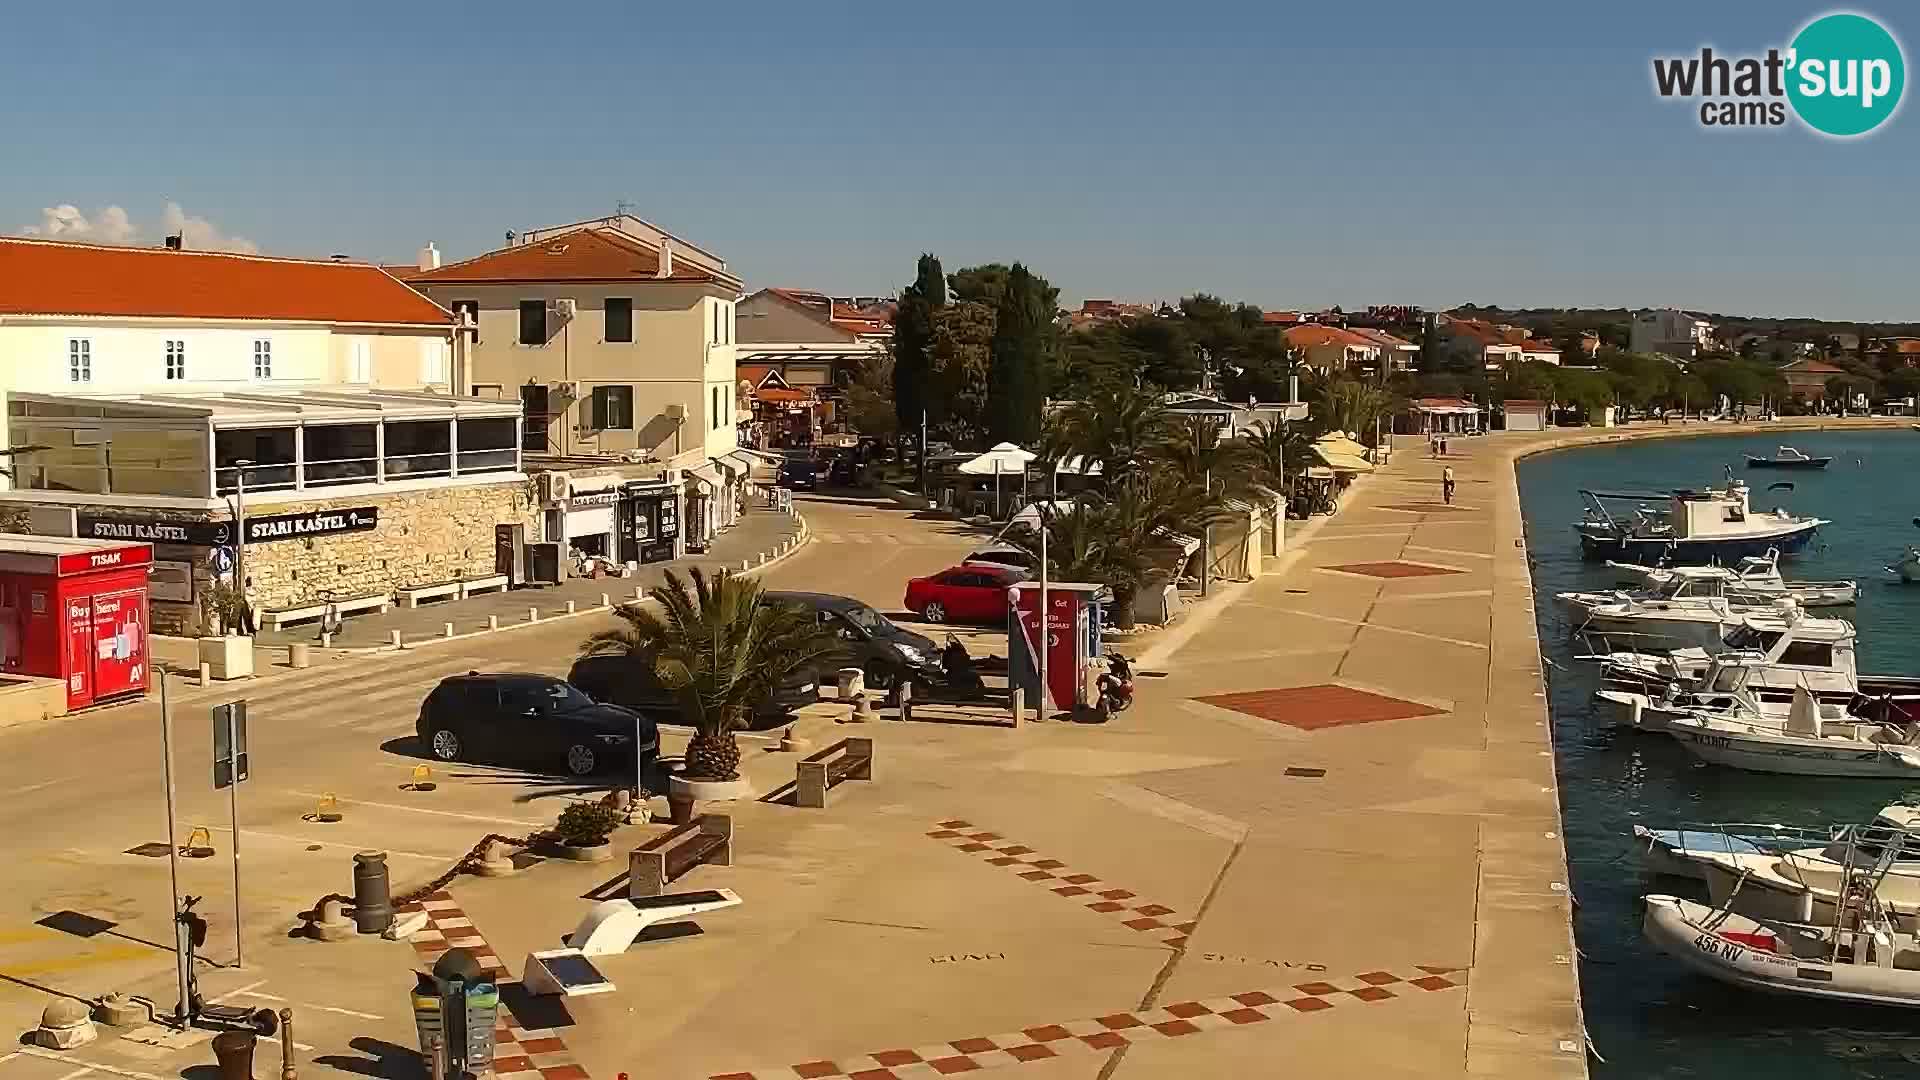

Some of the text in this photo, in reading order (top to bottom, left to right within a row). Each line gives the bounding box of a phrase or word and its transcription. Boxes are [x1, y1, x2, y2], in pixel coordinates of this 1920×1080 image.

[94, 522, 187, 540] STARI KAŠTEL
[251, 514, 346, 538] STARI KAŠTEL
[91, 552, 121, 567] TISAK
[1693, 933, 1720, 954] 456
[1721, 943, 1744, 962] NV
